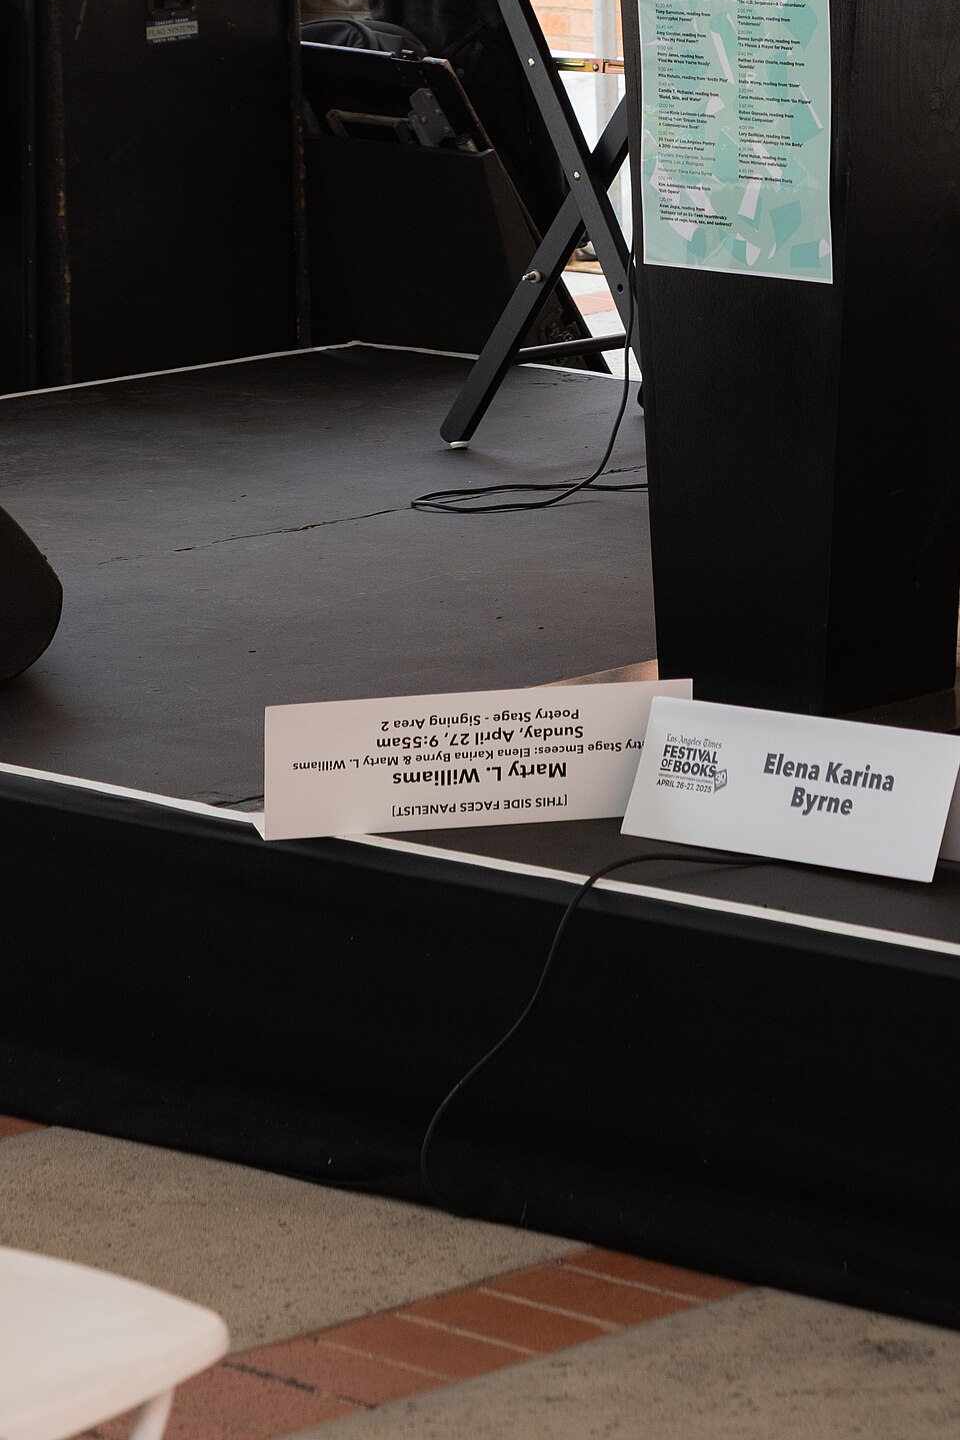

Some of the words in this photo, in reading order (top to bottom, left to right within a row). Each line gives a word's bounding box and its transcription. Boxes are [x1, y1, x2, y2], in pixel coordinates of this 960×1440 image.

[493, 710, 531, 722] Stage
[535, 708, 579, 719] Poetry
[381, 721, 389, 731] 2
[394, 719, 425, 729] Area
[430, 713, 481, 728] Signing
[444, 732, 470, 746] 27,
[475, 727, 514, 745] April
[520, 725, 584, 741] Sunday,
[377, 735, 439, 749] 9:55am
[588, 741, 622, 752] Stage
[625, 739, 644, 750] try
[667, 733, 677, 742] Los
[678, 735, 701, 746] Angeles
[703, 738, 722, 749] Times
[455, 750, 494, 761] Karina
[498, 748, 530, 758] Elena
[535, 745, 584, 754] Emcees:
[663, 744, 718, 764] FESTIVAL
[363, 755, 398, 766] Marty
[403, 756, 412, 765] &
[416, 751, 450, 762] Byrne
[293, 760, 346, 771] Williams
[350, 759, 359, 768] L.
[508, 761, 566, 778] Marty
[661, 759, 673, 768] OF
[673, 760, 716, 778] BOOKS
[392, 768, 480, 786] Williams
[486, 766, 502, 781] L.
[763, 753, 819, 781] Elena
[825, 761, 895, 792] Karina
[656, 779, 674, 788] APRIL
[696, 784, 711, 793] 2025
[460, 800, 500, 812] FACES
[503, 798, 532, 809] SIDE
[536, 794, 567, 808] [THIS
[791, 787, 853, 816] Byrne
[392, 804, 456, 817] PANELIST]
